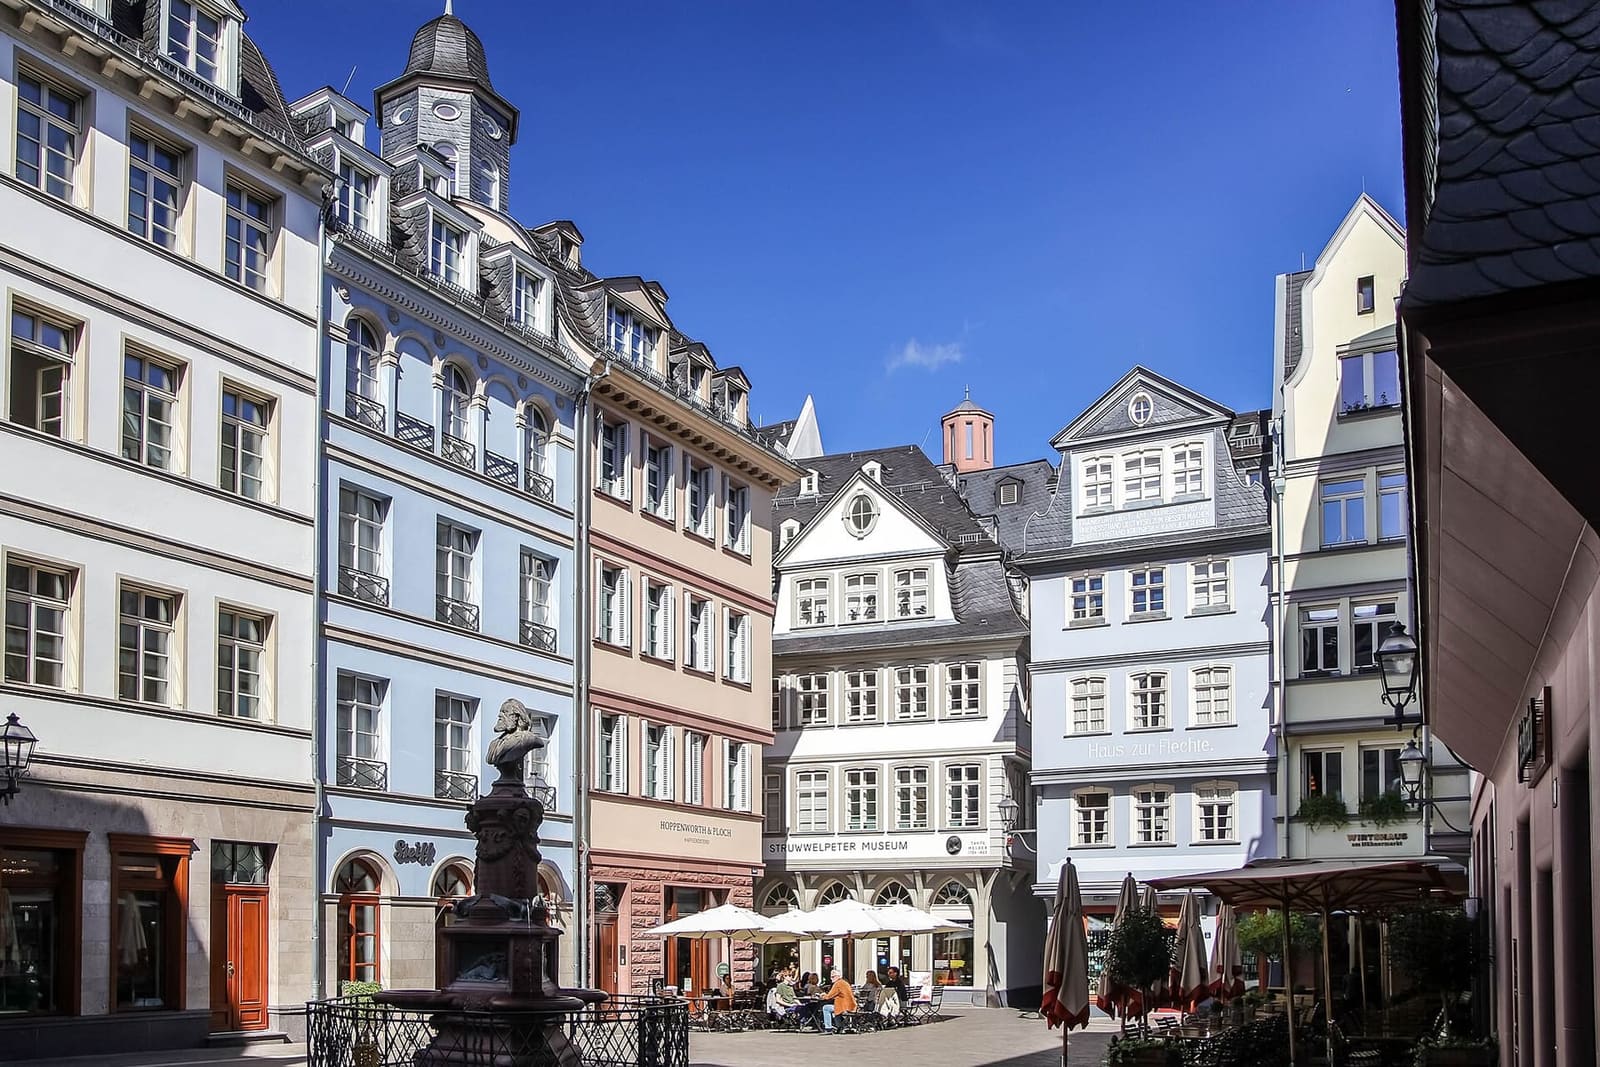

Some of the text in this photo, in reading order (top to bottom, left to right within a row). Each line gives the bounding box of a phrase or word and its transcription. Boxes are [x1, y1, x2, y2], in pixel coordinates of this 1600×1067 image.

[1088, 742, 1125, 759] Haus
[660, 820, 707, 835] HOPPENWORTH
[713, 827, 732, 837] PLOCH
[393, 839, 436, 867] Steiff
[769, 841, 908, 853] STRUWWELPETER MUSEUM
